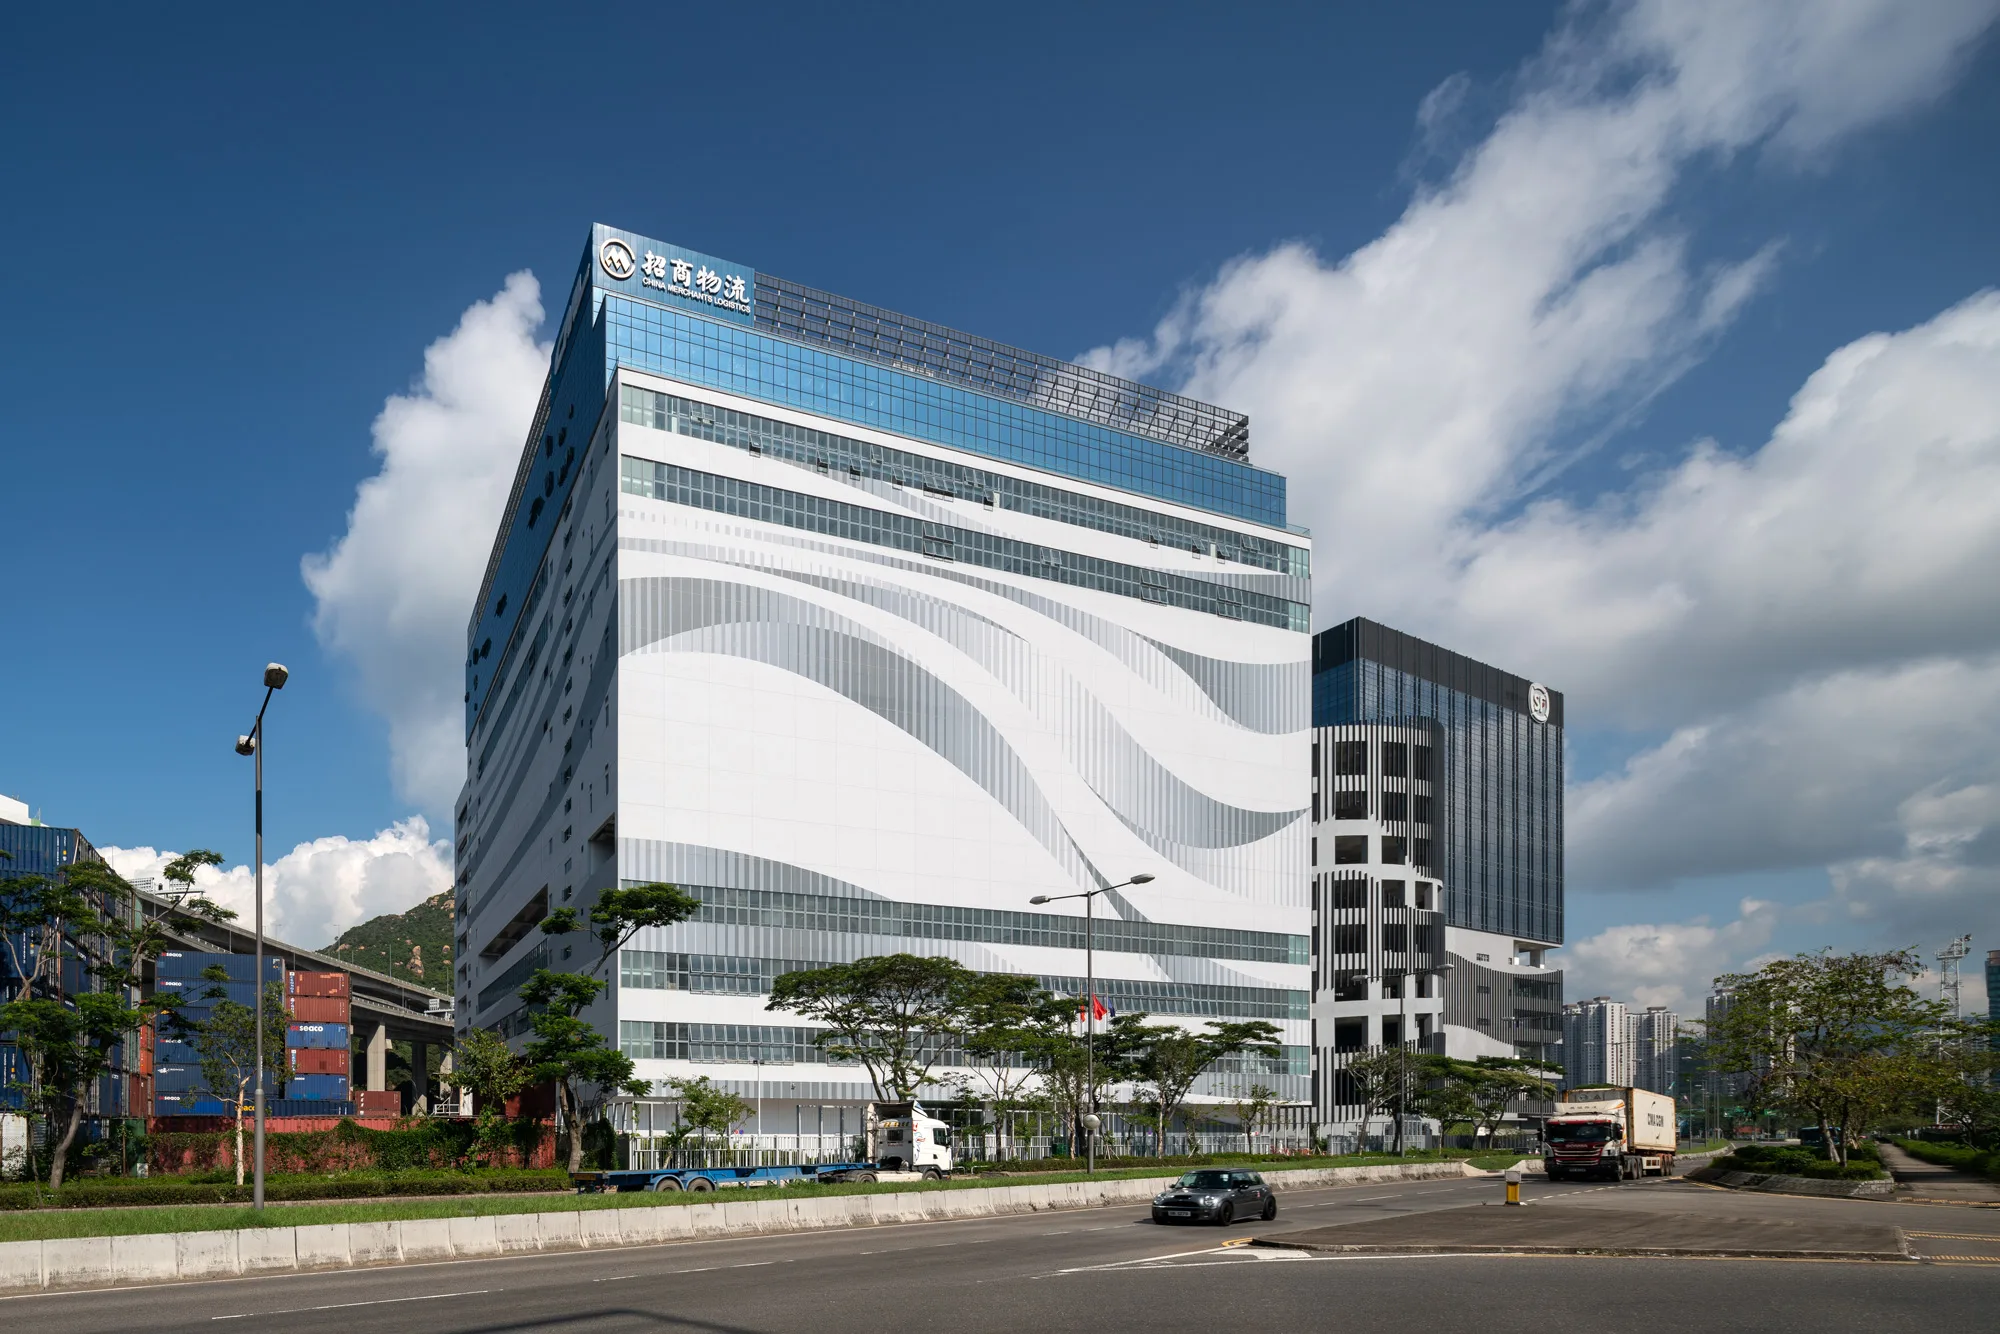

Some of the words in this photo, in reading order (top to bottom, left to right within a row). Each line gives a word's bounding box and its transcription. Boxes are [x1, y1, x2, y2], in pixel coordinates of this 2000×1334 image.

[641, 250, 751, 303] 招商物流
[642, 277, 666, 290] CHINA
[667, 285, 713, 304] MERCHANTS
[713, 297, 751, 314] LOGISTICS
